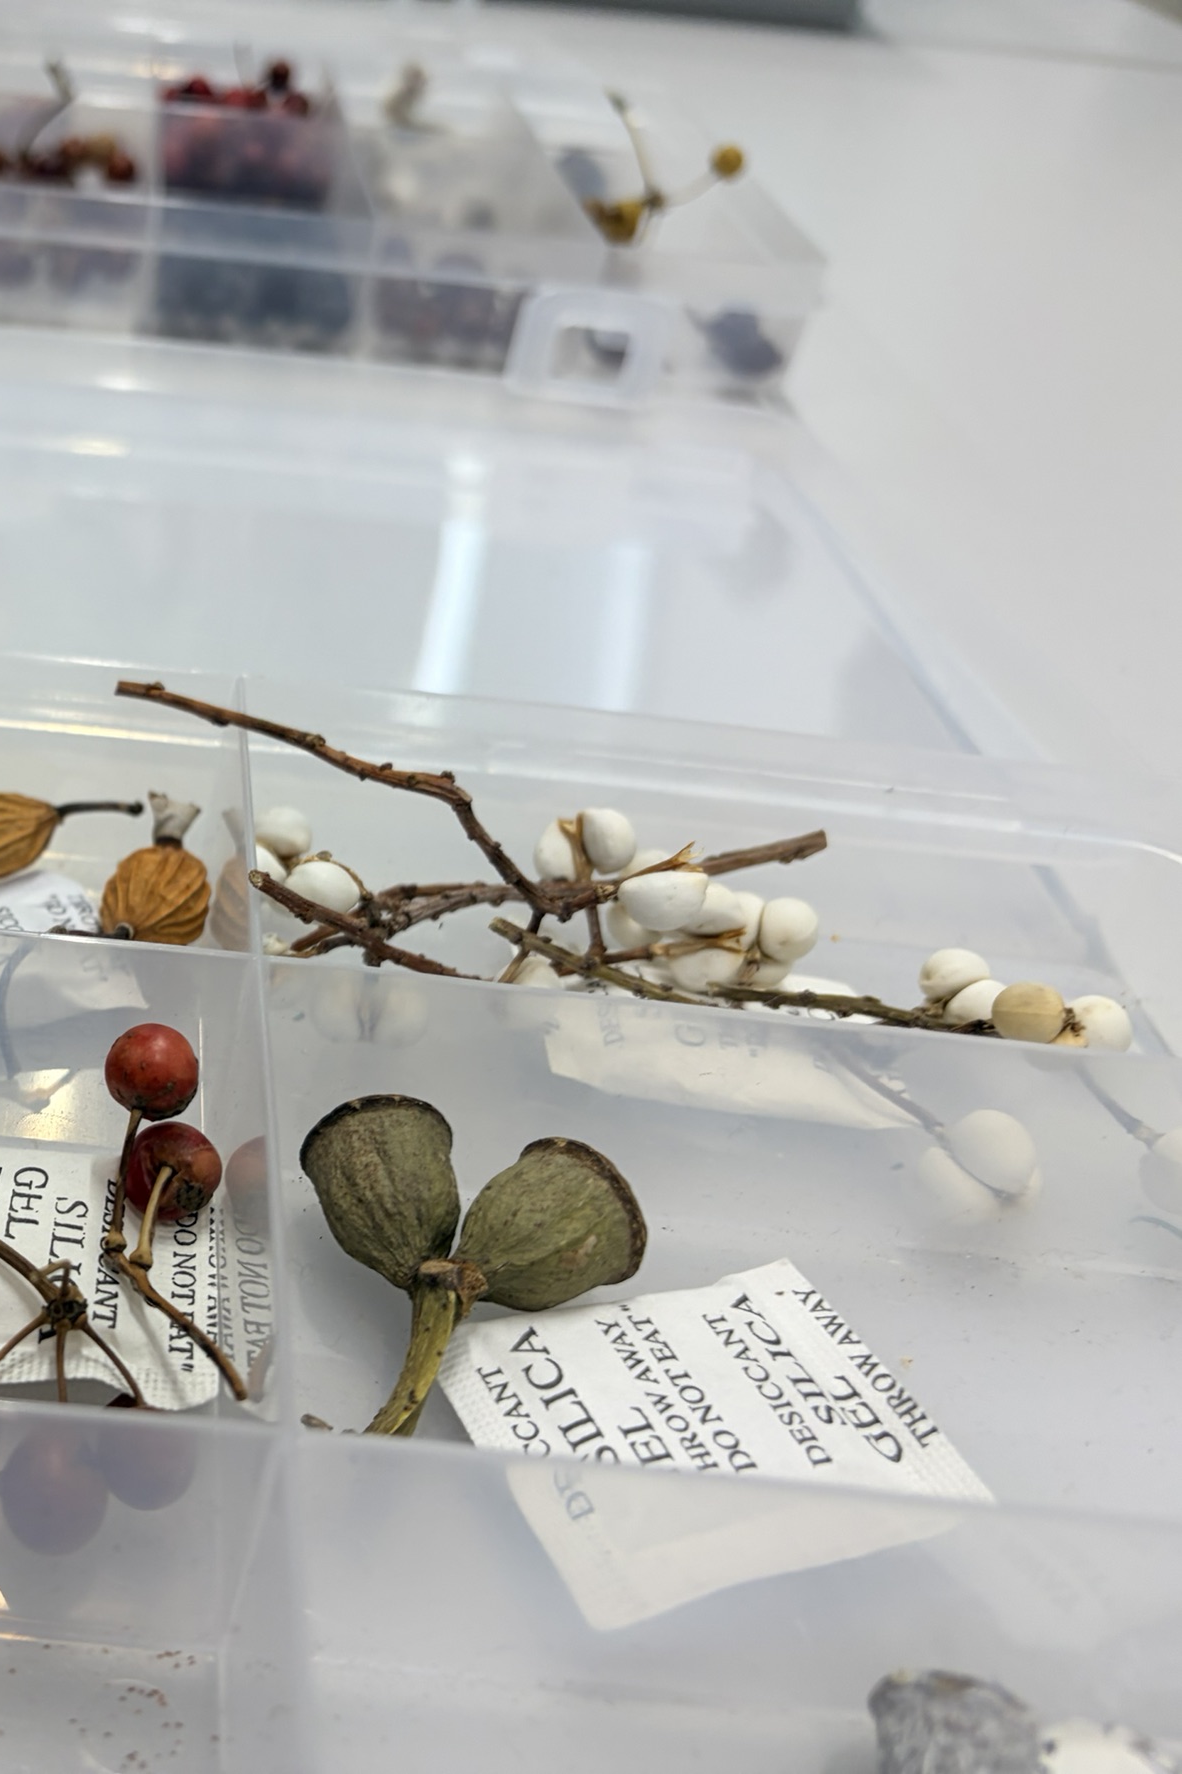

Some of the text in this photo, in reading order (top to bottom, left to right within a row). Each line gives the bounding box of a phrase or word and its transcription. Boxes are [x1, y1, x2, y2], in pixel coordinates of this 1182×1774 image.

[4, 1166, 49, 1240] GEL
[92, 1178, 124, 1330] DESANT
[171, 1250, 197, 1307] NOT
[593, 1319, 720, 1472] HROW AWAY
[663, 1367, 724, 1426] NOT
[702, 1313, 834, 1468] DESICCANT
[730, 1292, 847, 1426] SILICA
[791, 1289, 939, 1449] THROW AWAY
[617, 1405, 676, 1467] EL
[829, 1374, 904, 1464] GEL
